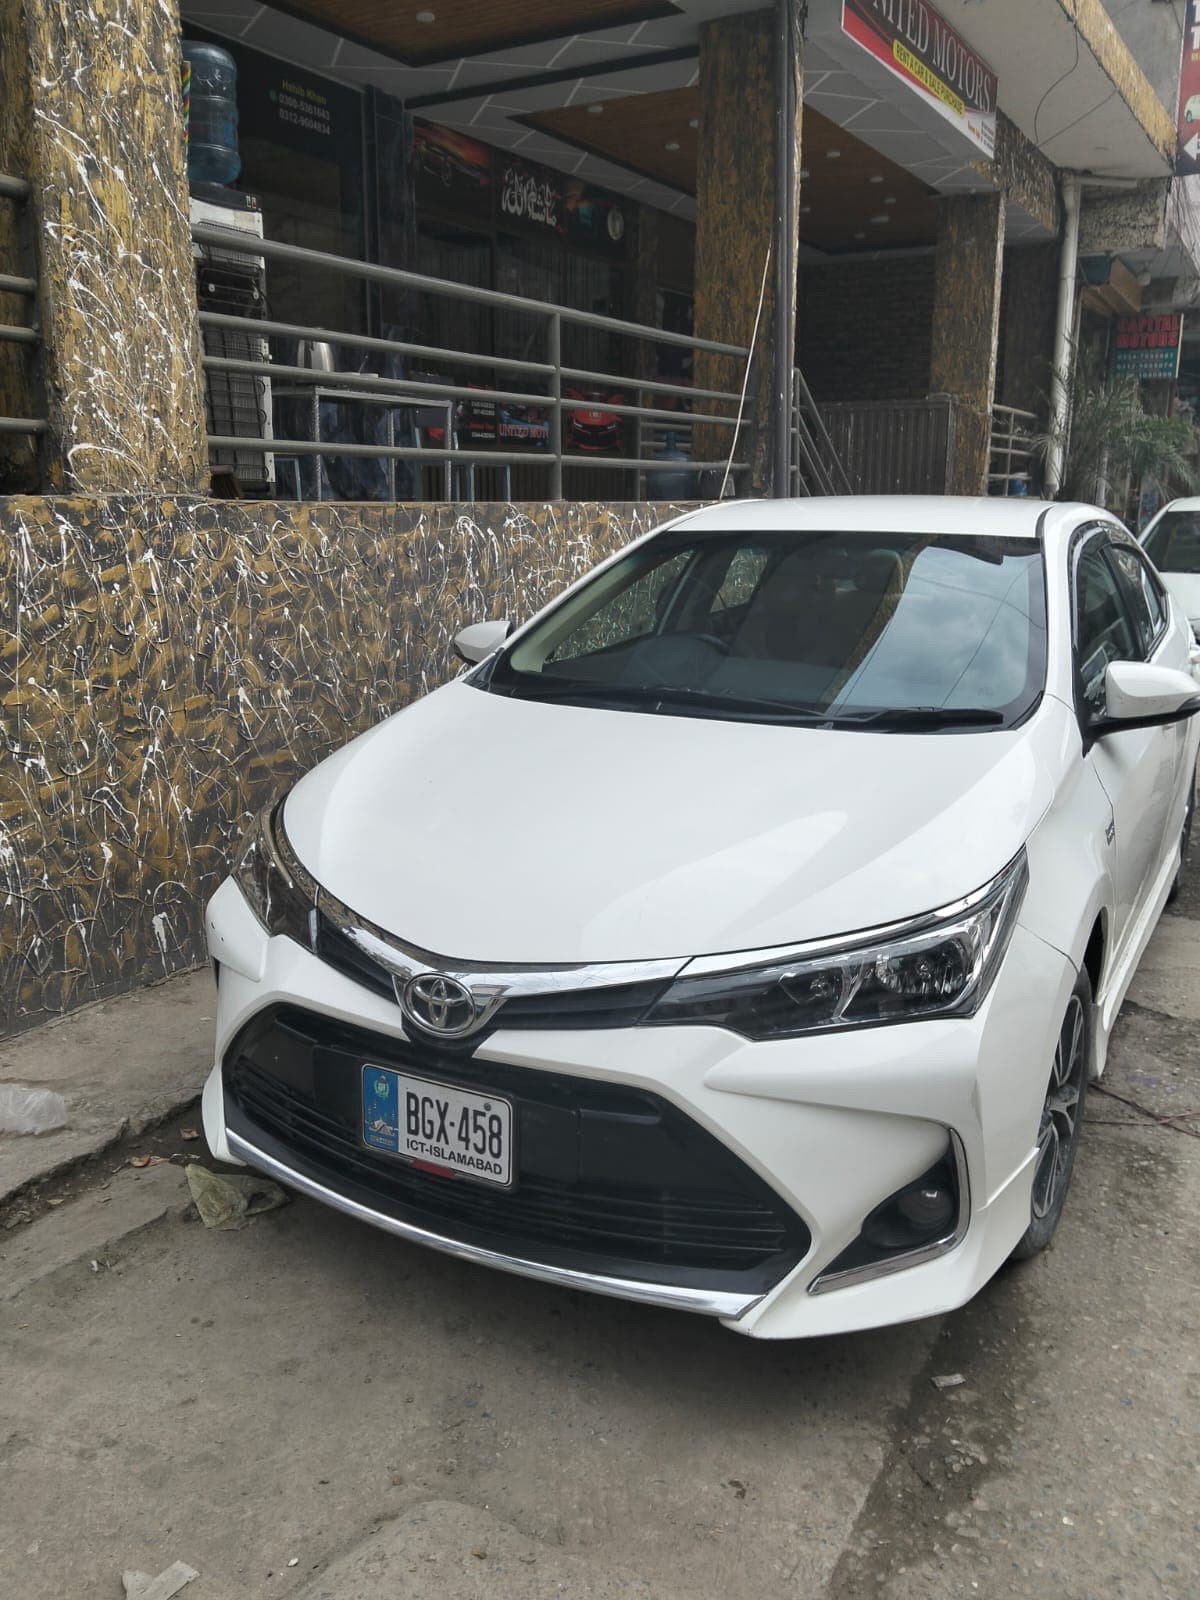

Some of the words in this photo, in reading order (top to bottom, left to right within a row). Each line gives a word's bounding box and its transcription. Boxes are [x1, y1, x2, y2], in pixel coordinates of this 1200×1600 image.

[873, 0, 930, 53] NITED
[933, 19, 992, 114] MOTORS
[896, 43, 910, 68] RENT
[406, 1091, 503, 1160] BGX-458
[406, 1138, 503, 1176] ICT-ISLAMABAD
